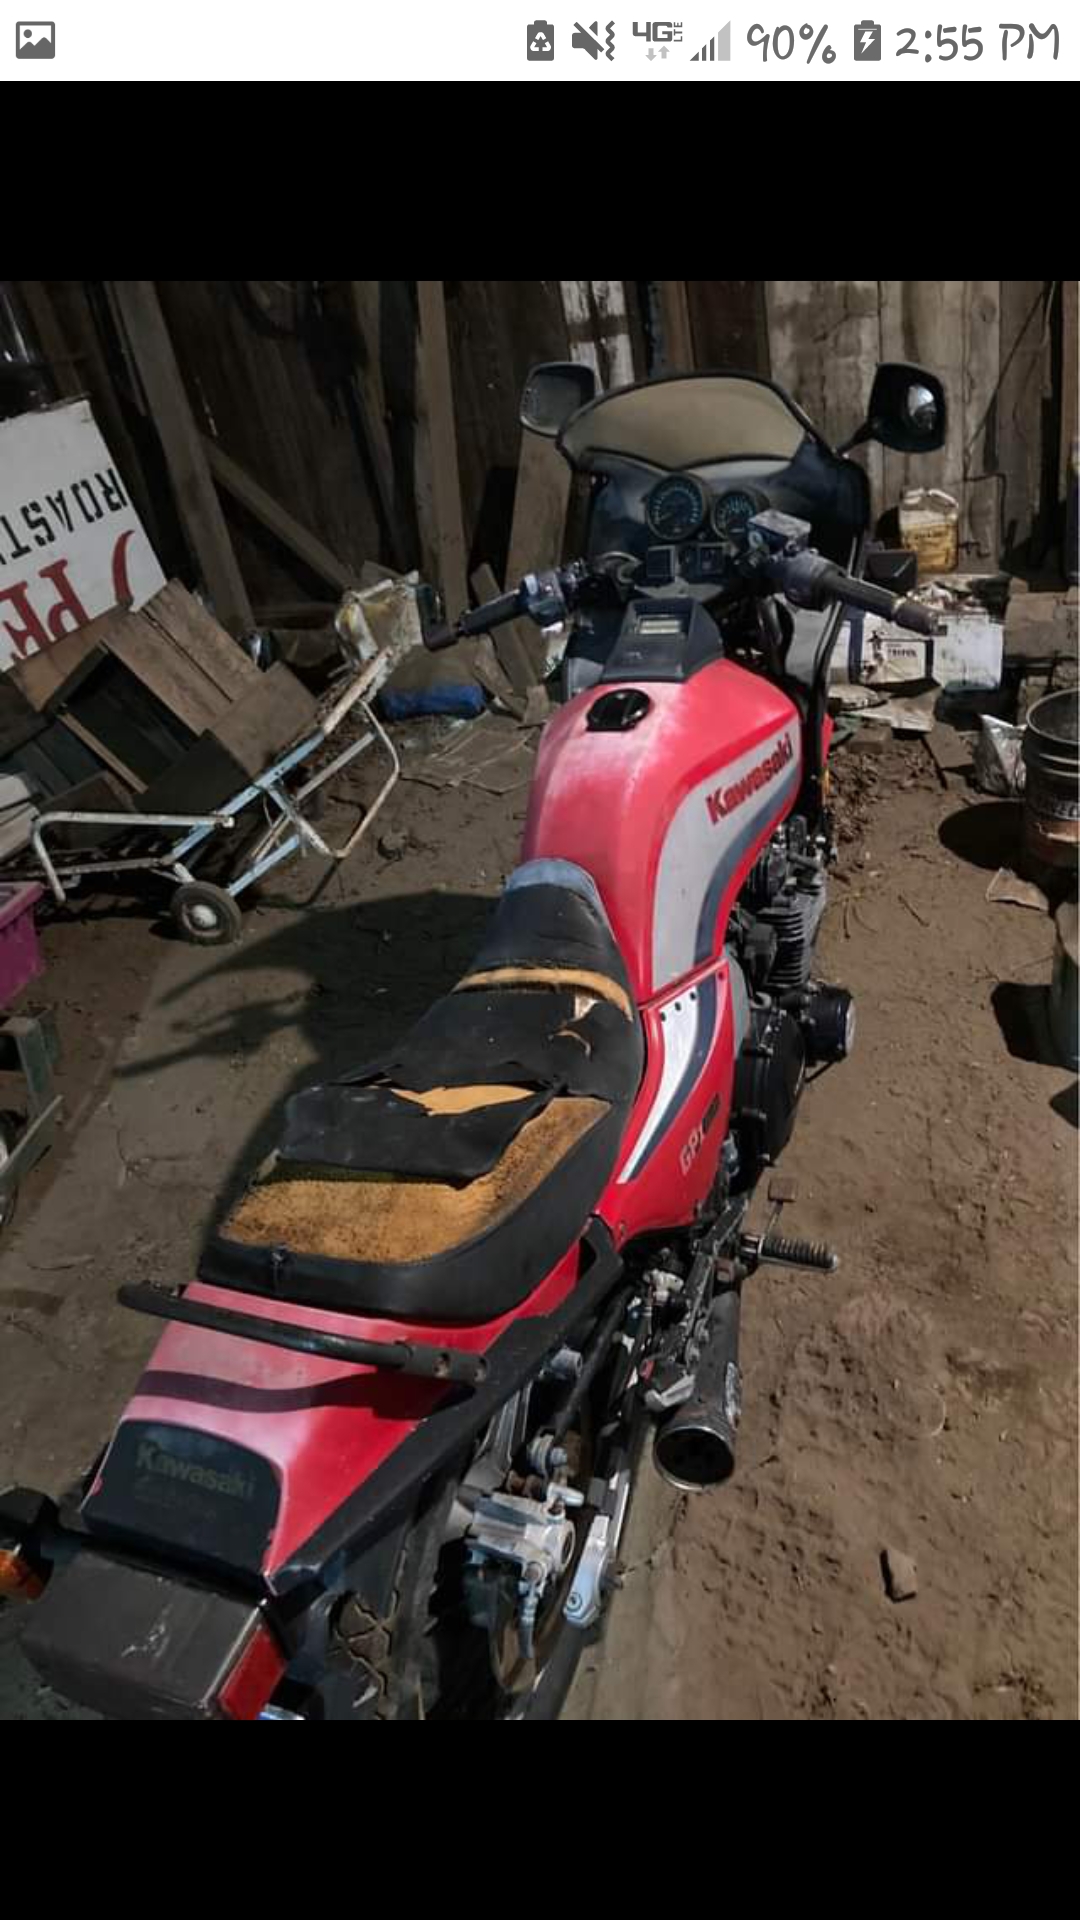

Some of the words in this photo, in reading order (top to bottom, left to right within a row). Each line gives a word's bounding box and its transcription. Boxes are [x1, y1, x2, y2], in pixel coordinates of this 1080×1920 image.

[0, 467, 128, 566] ROAST
[705, 731, 794, 826] Kawasaki
[135, 1437, 257, 1499] Kawasaki
